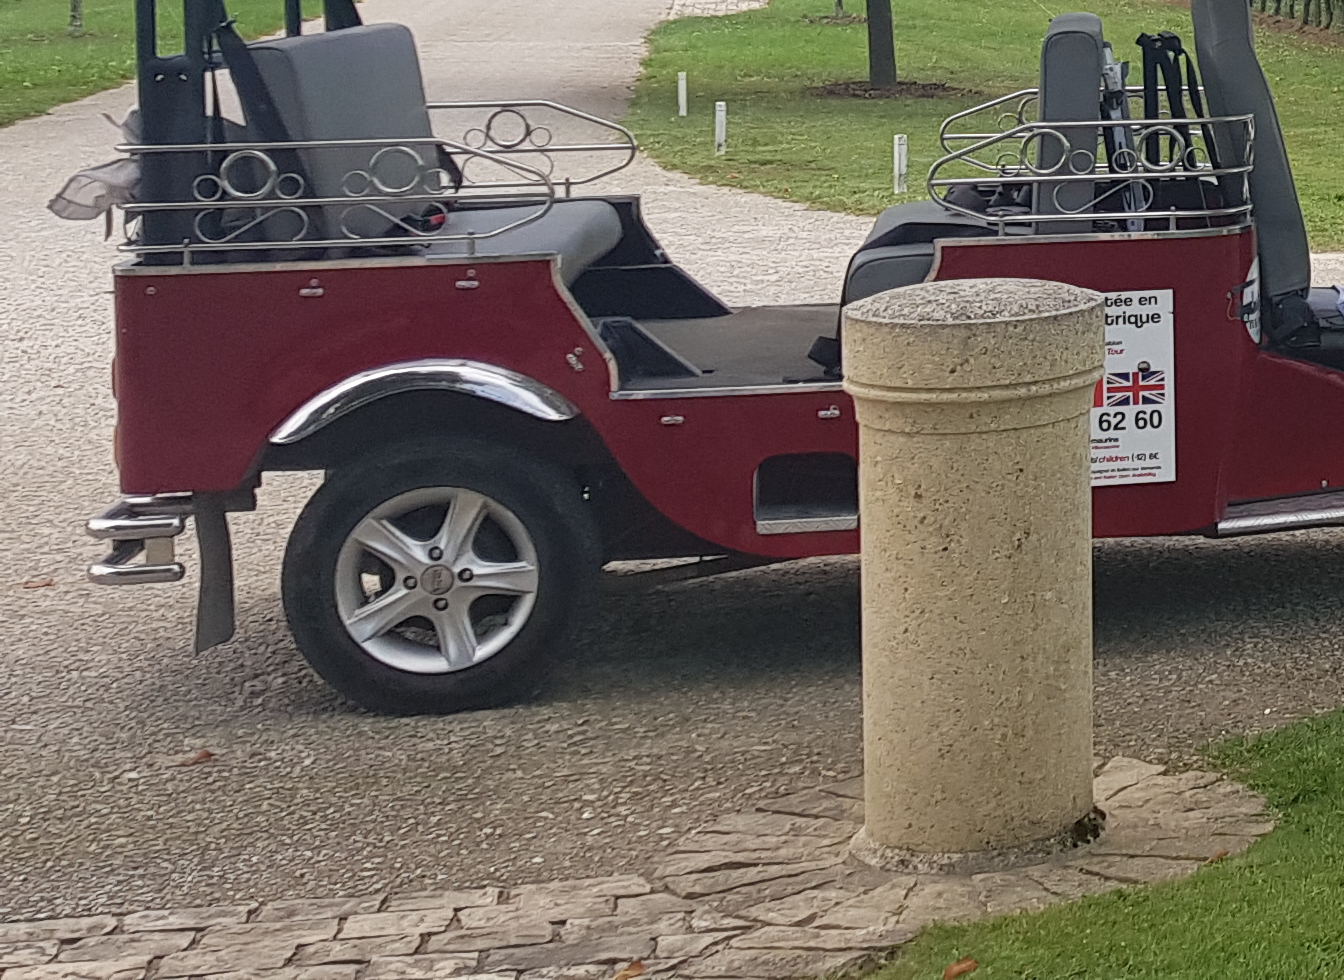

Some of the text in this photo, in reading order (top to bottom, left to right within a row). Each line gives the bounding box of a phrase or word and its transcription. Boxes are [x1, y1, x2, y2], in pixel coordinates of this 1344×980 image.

[1138, 295, 1158, 306] en
[1098, 409, 1163, 432] 62 60
